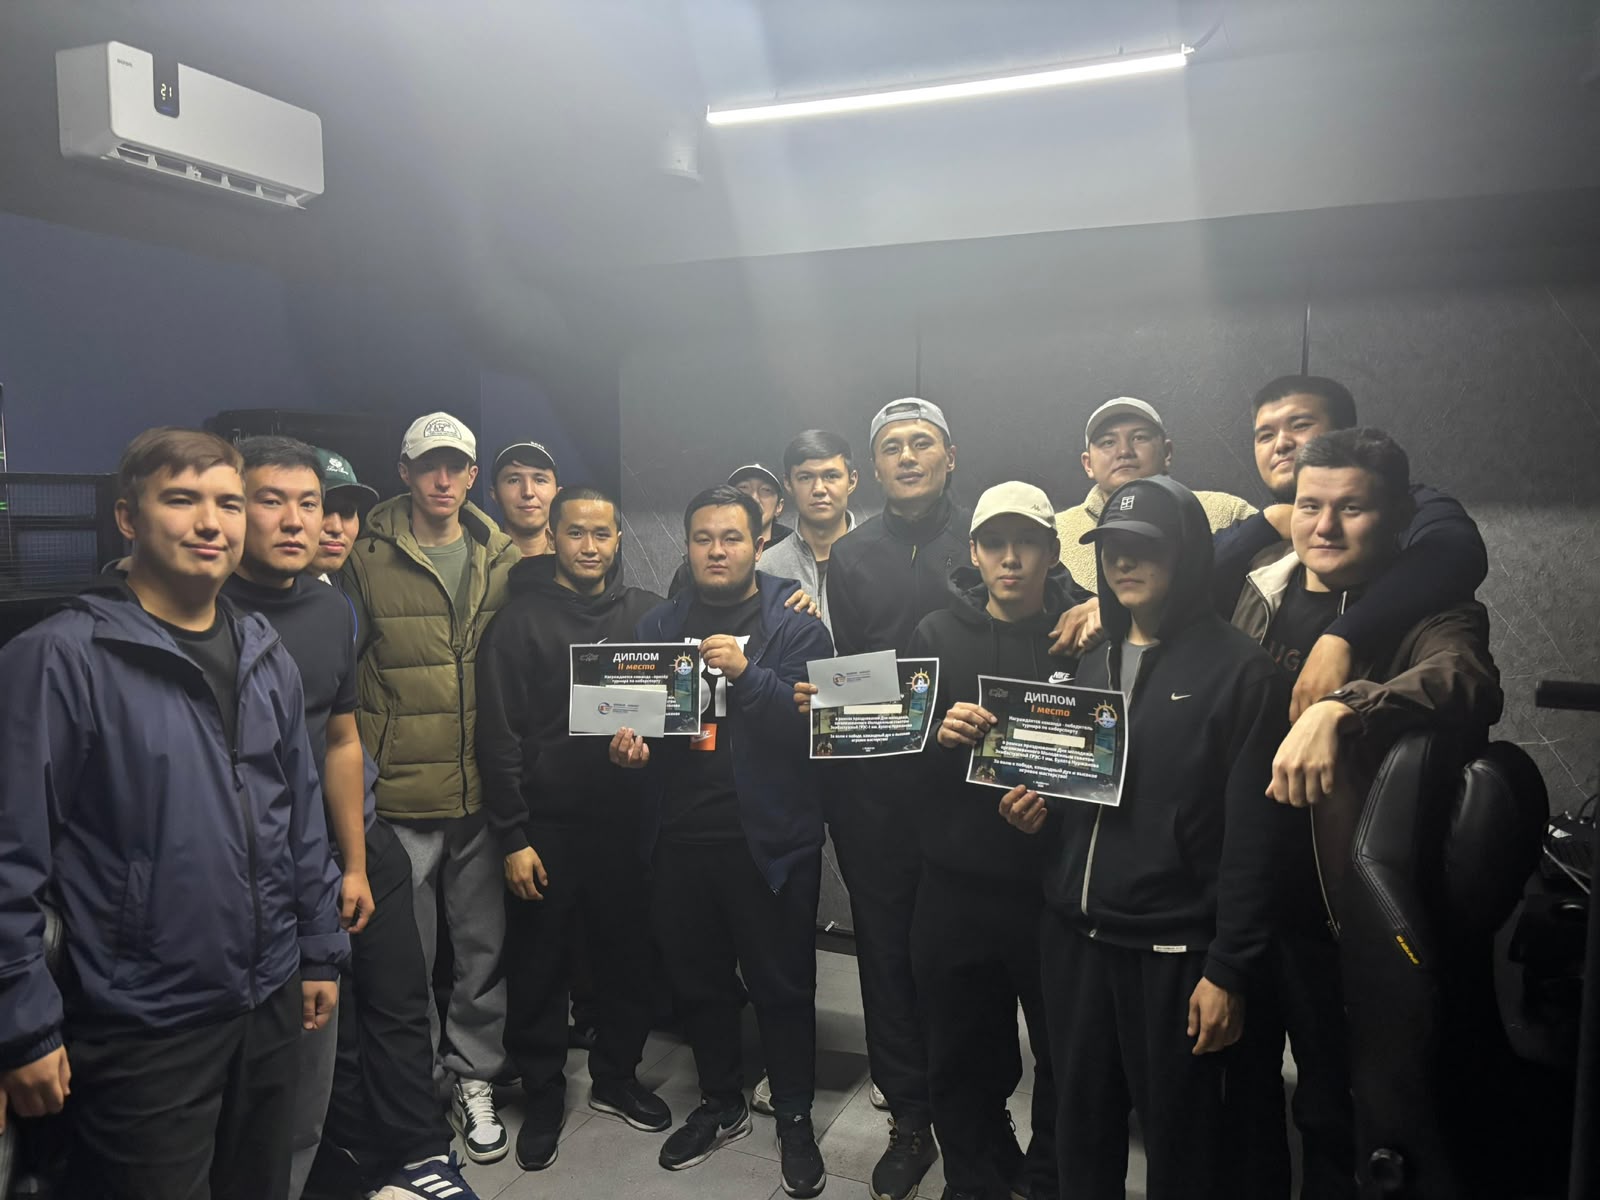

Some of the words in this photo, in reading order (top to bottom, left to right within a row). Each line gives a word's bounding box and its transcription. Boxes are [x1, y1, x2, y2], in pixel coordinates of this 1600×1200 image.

[613, 652, 660, 663] ДИПЛОМ
[1024, 691, 1076, 706] ДИПЛОМ
[1036, 706, 1070, 717] место
